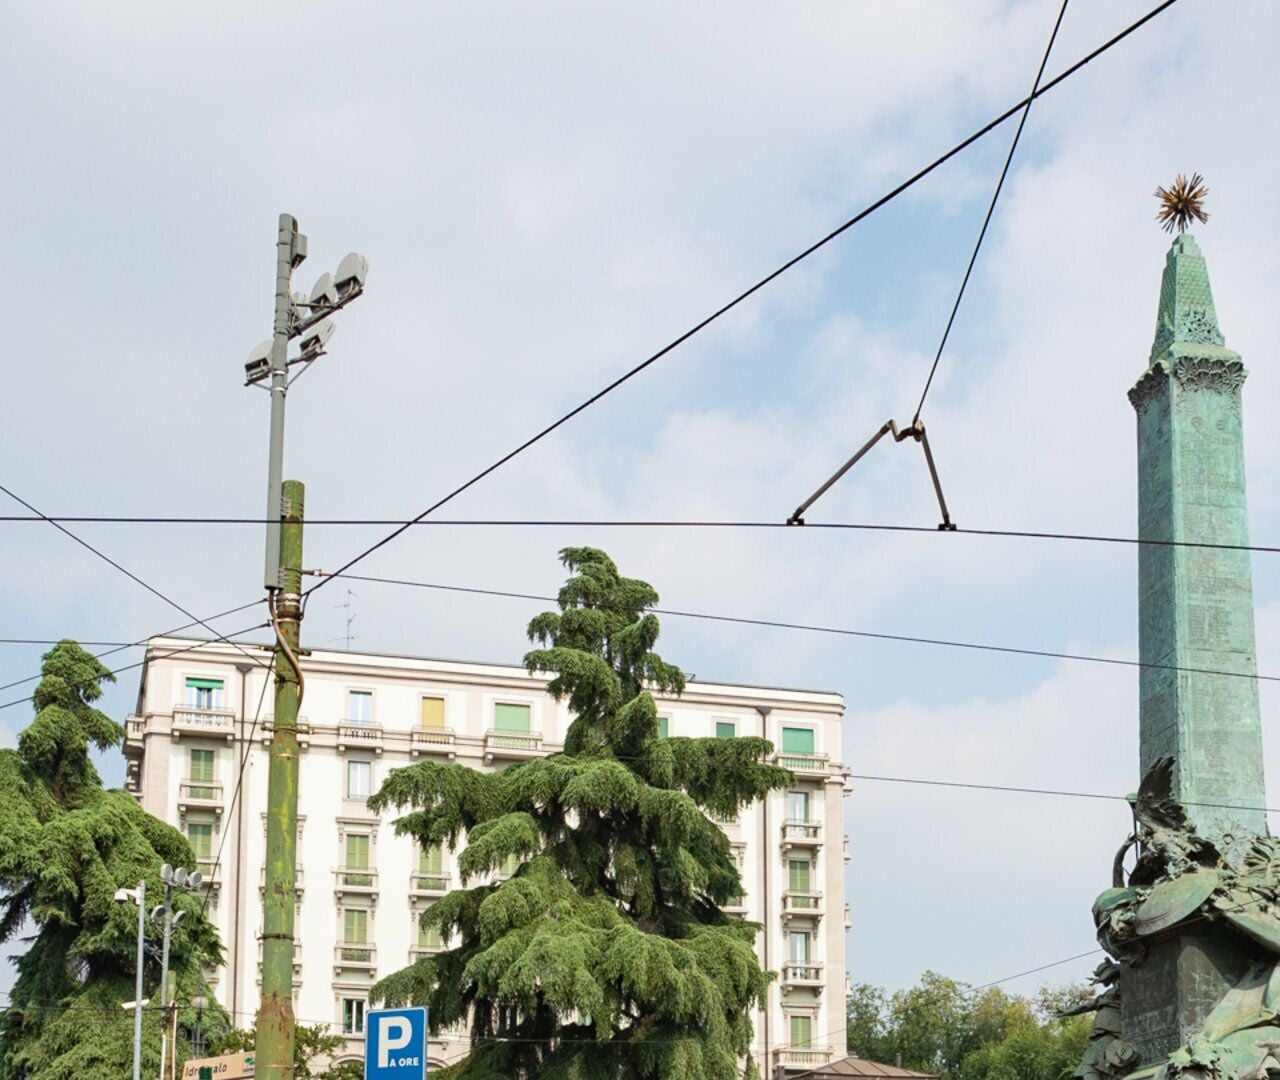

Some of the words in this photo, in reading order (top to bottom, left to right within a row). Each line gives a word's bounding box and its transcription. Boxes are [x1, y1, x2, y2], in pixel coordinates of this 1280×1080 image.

[377, 1015, 413, 1068] P
[184, 1062, 228, 1077] Idralo
[388, 1058, 397, 1067] A
[398, 1057, 419, 1067] ORE
